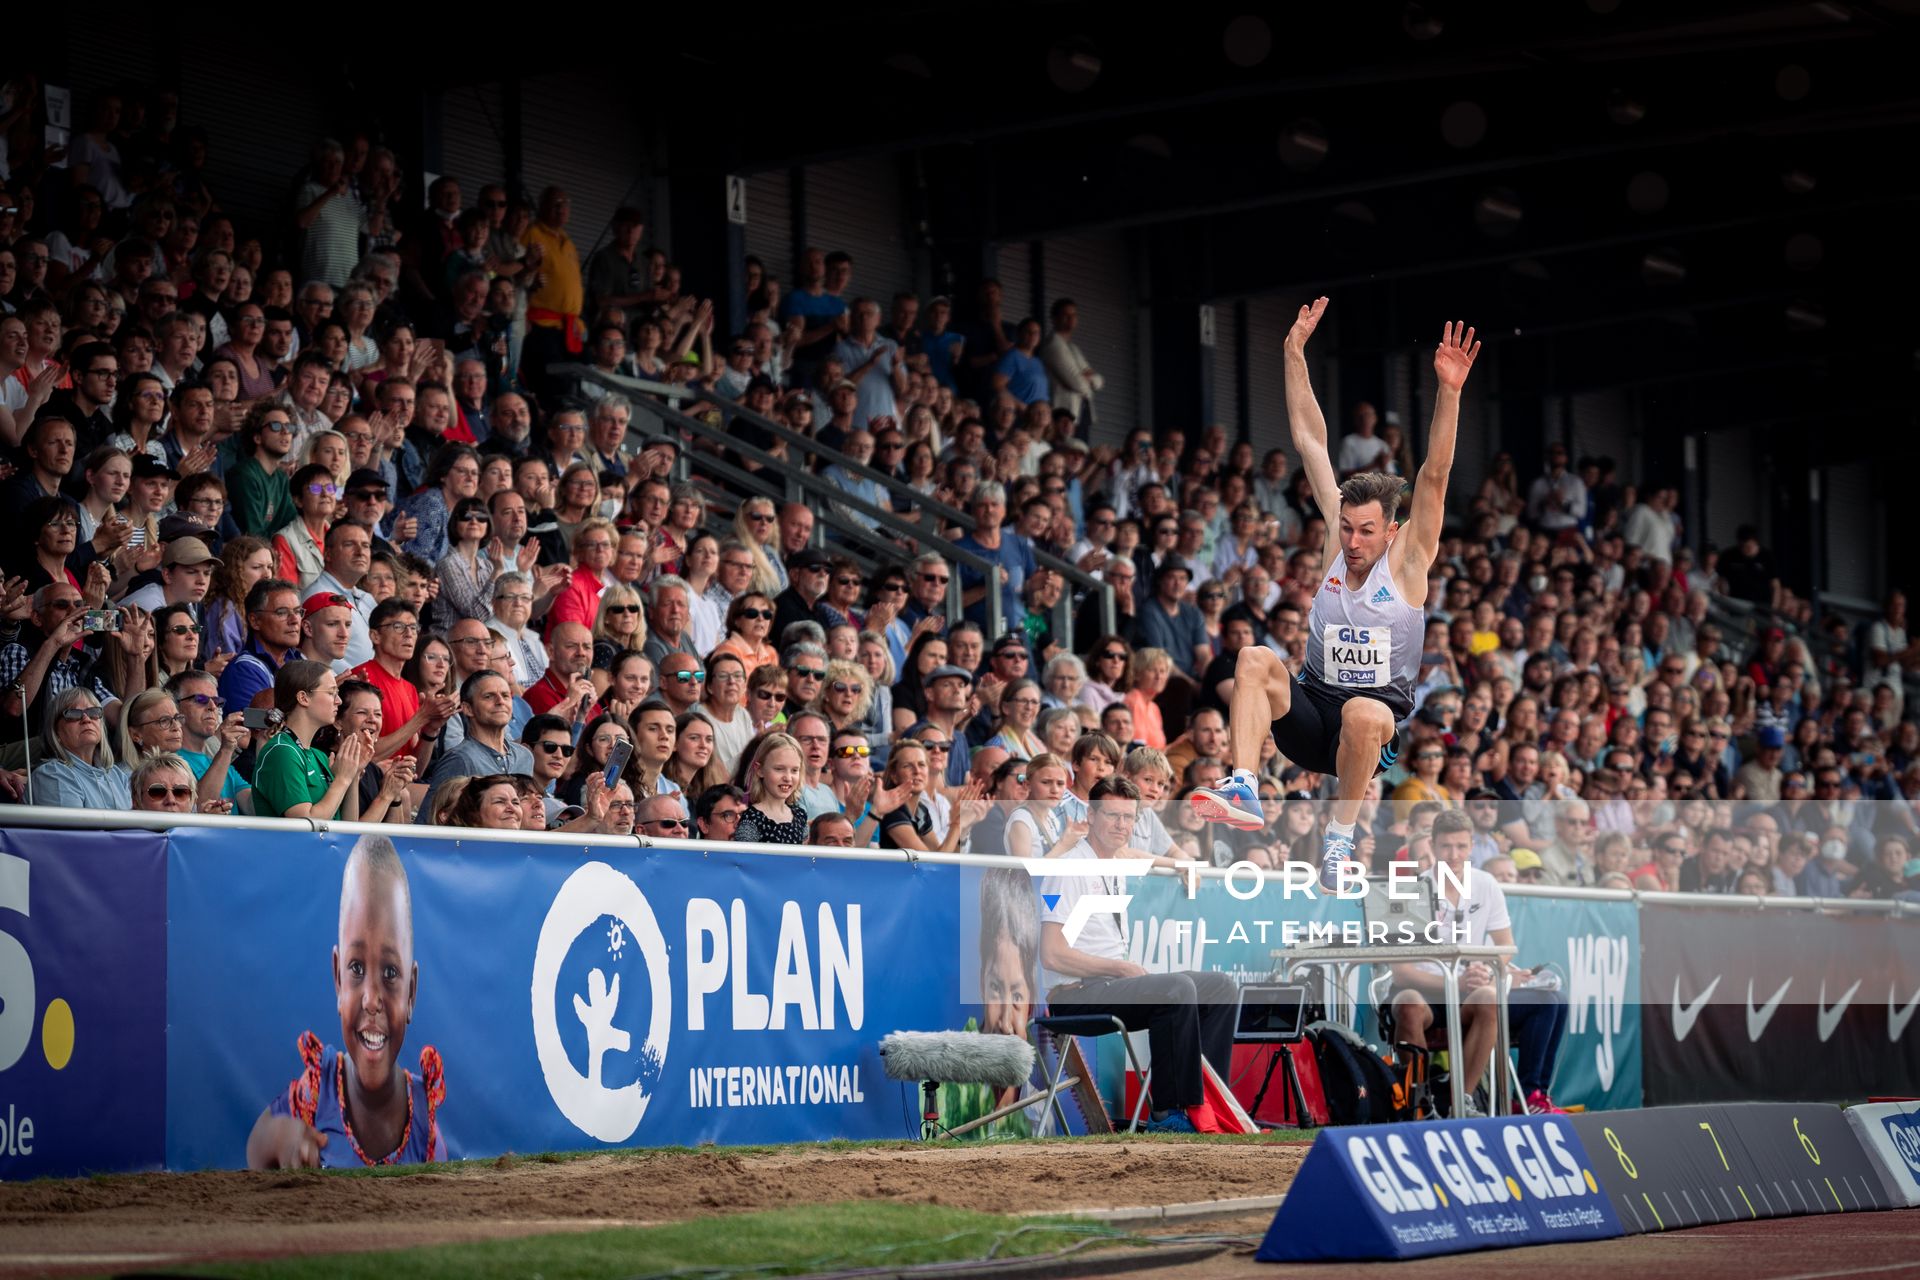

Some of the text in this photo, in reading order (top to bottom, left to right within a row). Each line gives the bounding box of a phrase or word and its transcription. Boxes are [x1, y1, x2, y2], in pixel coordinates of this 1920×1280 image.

[1371, 595, 1394, 604] adidas
[1339, 627, 1377, 645] GLS.
[1332, 646, 1384, 666] KAUL
[1353, 672, 1374, 680] PLAN
[685, 897, 865, 1032] PLAN
[689, 1065, 865, 1108] INTERNATIONAL
[1604, 1127, 1639, 1180] 8
[1699, 1122, 1731, 1172] 7
[1792, 1117, 1821, 1166] 6
[1540, 1208, 1573, 1229] Parcels
[1574, 1204, 1605, 1230] People
